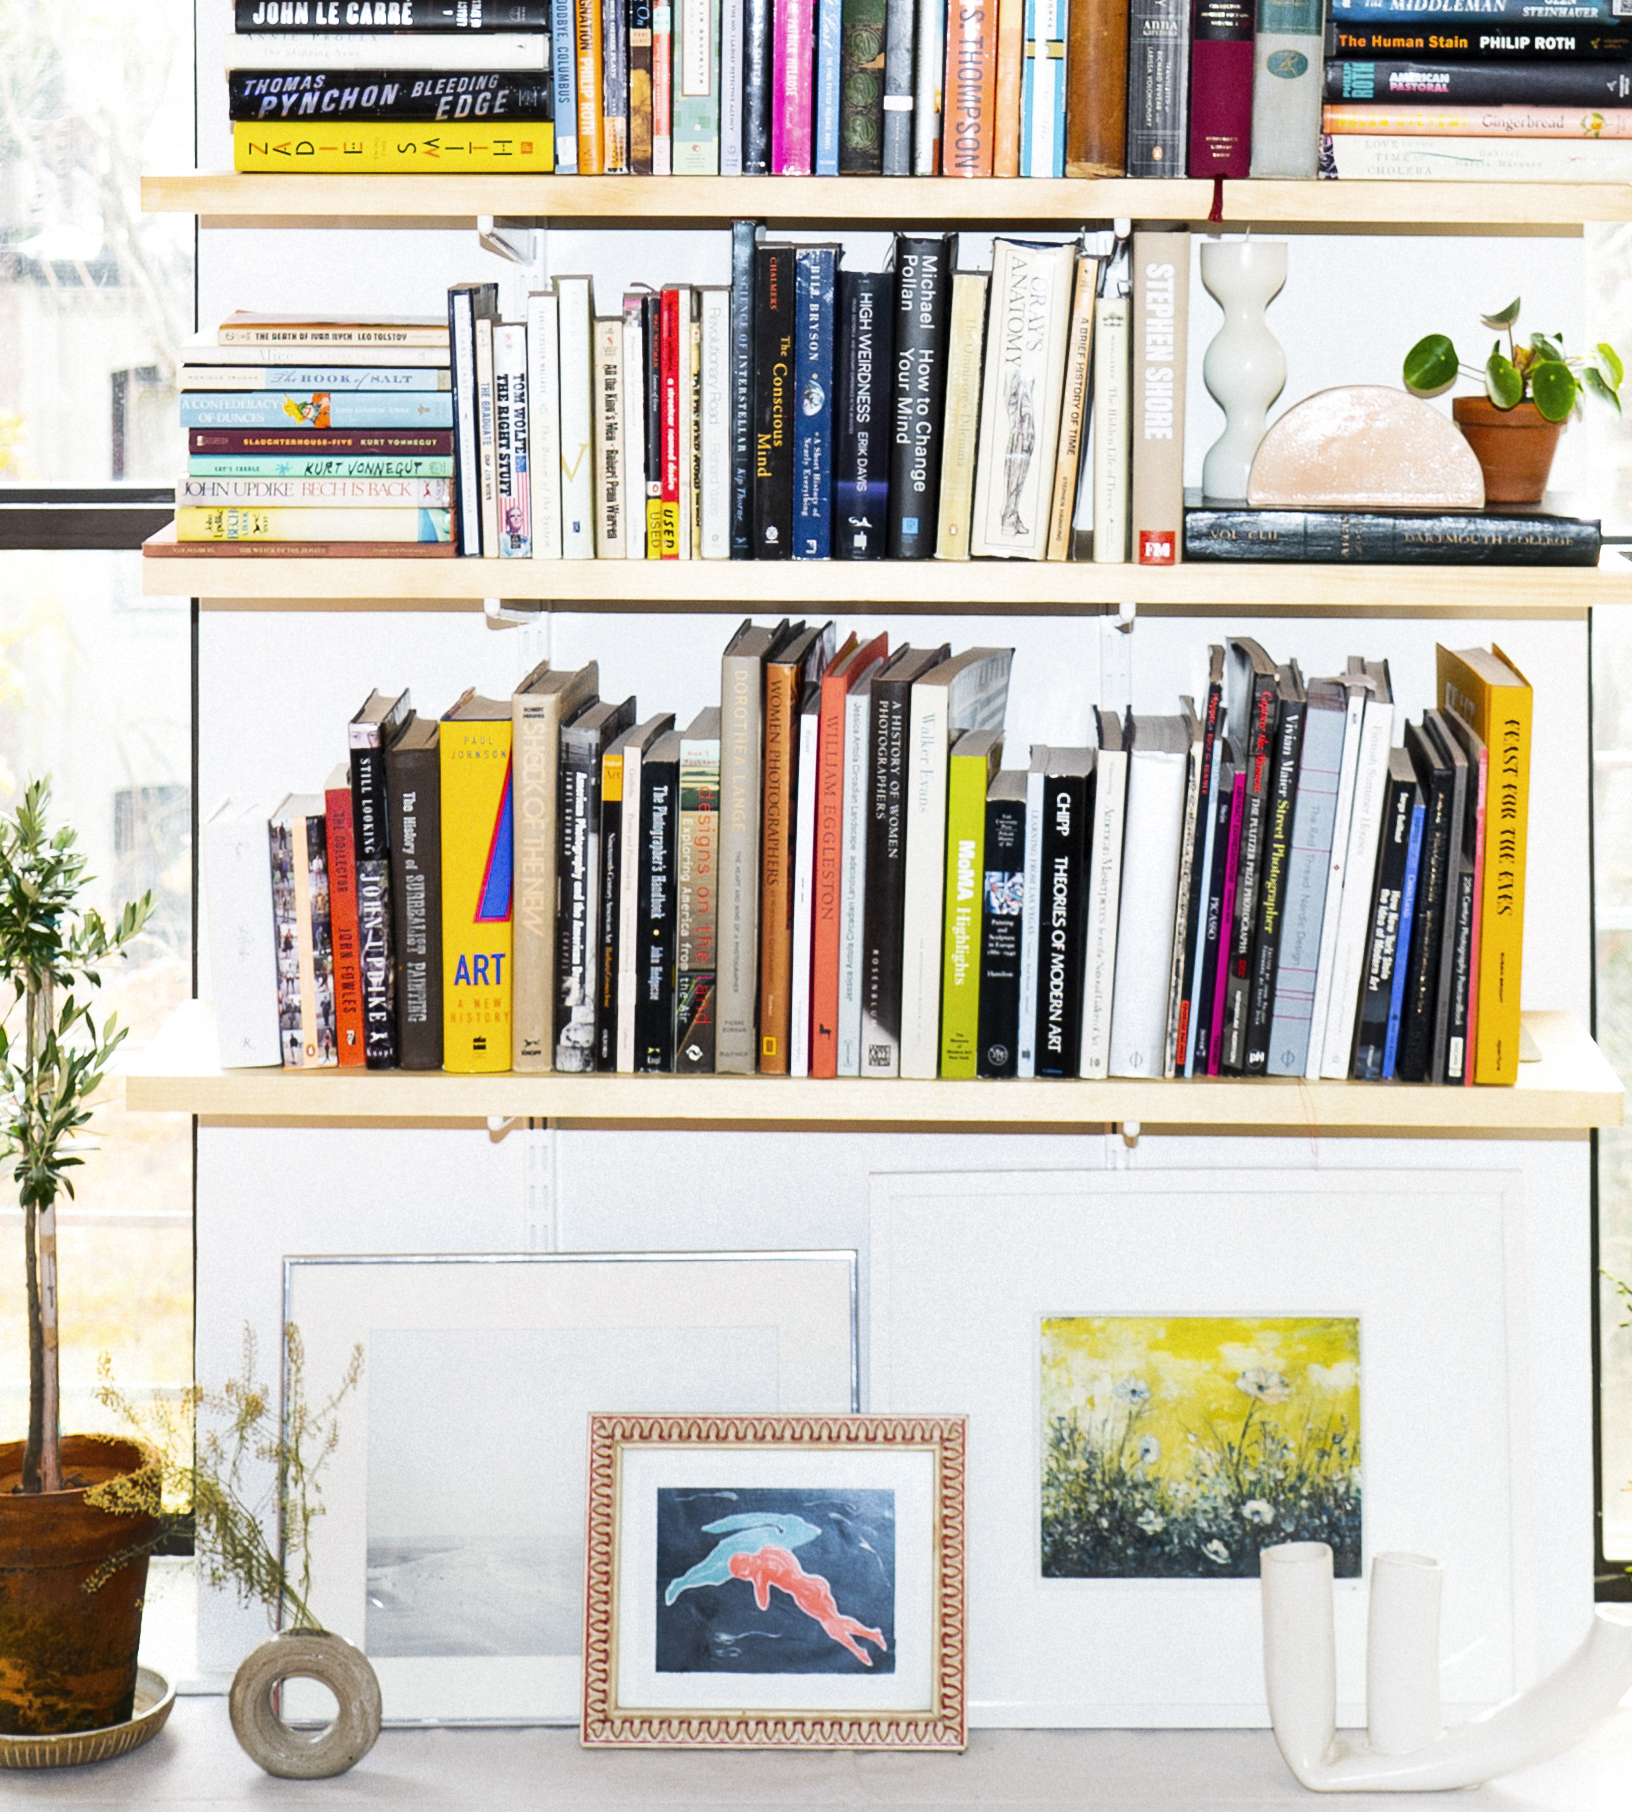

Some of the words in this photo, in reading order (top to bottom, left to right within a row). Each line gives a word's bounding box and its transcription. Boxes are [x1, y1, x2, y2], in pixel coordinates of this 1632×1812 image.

[253, 2, 309, 25] JOHN
[316, 2, 339, 25] LE
[956, 8, 985, 29] S.
[1340, 35, 1366, 46] The
[1372, 36, 1423, 47] Human
[1429, 36, 1467, 48] Stain
[1480, 37, 1530, 49] PHILIP
[1535, 37, 1575, 50] ROTH
[245, 75, 326, 96] THOMAS
[257, 85, 399, 117] PYNCHON
[412, 75, 500, 98] BLEEDING
[436, 91, 509, 120] EDGE
[955, 36, 984, 168] THOMPSON
[902, 255, 918, 311] Pollan
[920, 255, 937, 329] Michael
[858, 293, 872, 330] HIGH
[1143, 262, 1174, 362] STEPHEN
[857, 335, 872, 423] WEIRDNESS
[1144, 367, 1173, 440] SHORE
[305, 462, 343, 476] KURT
[348, 462, 422, 477] VONNEGUT
[1404, 533, 1504, 546] DARTMOUTH
[1507, 535, 1575, 547] COLLEGE
[1056, 793, 1070, 836] CHIPP
[1052, 856, 1068, 927] THEORIES
[1052, 930, 1065, 951] OF
[454, 953, 505, 985] ART
[1049, 953, 1064, 1021] MODERN
[1048, 1024, 1061, 1052] ART
